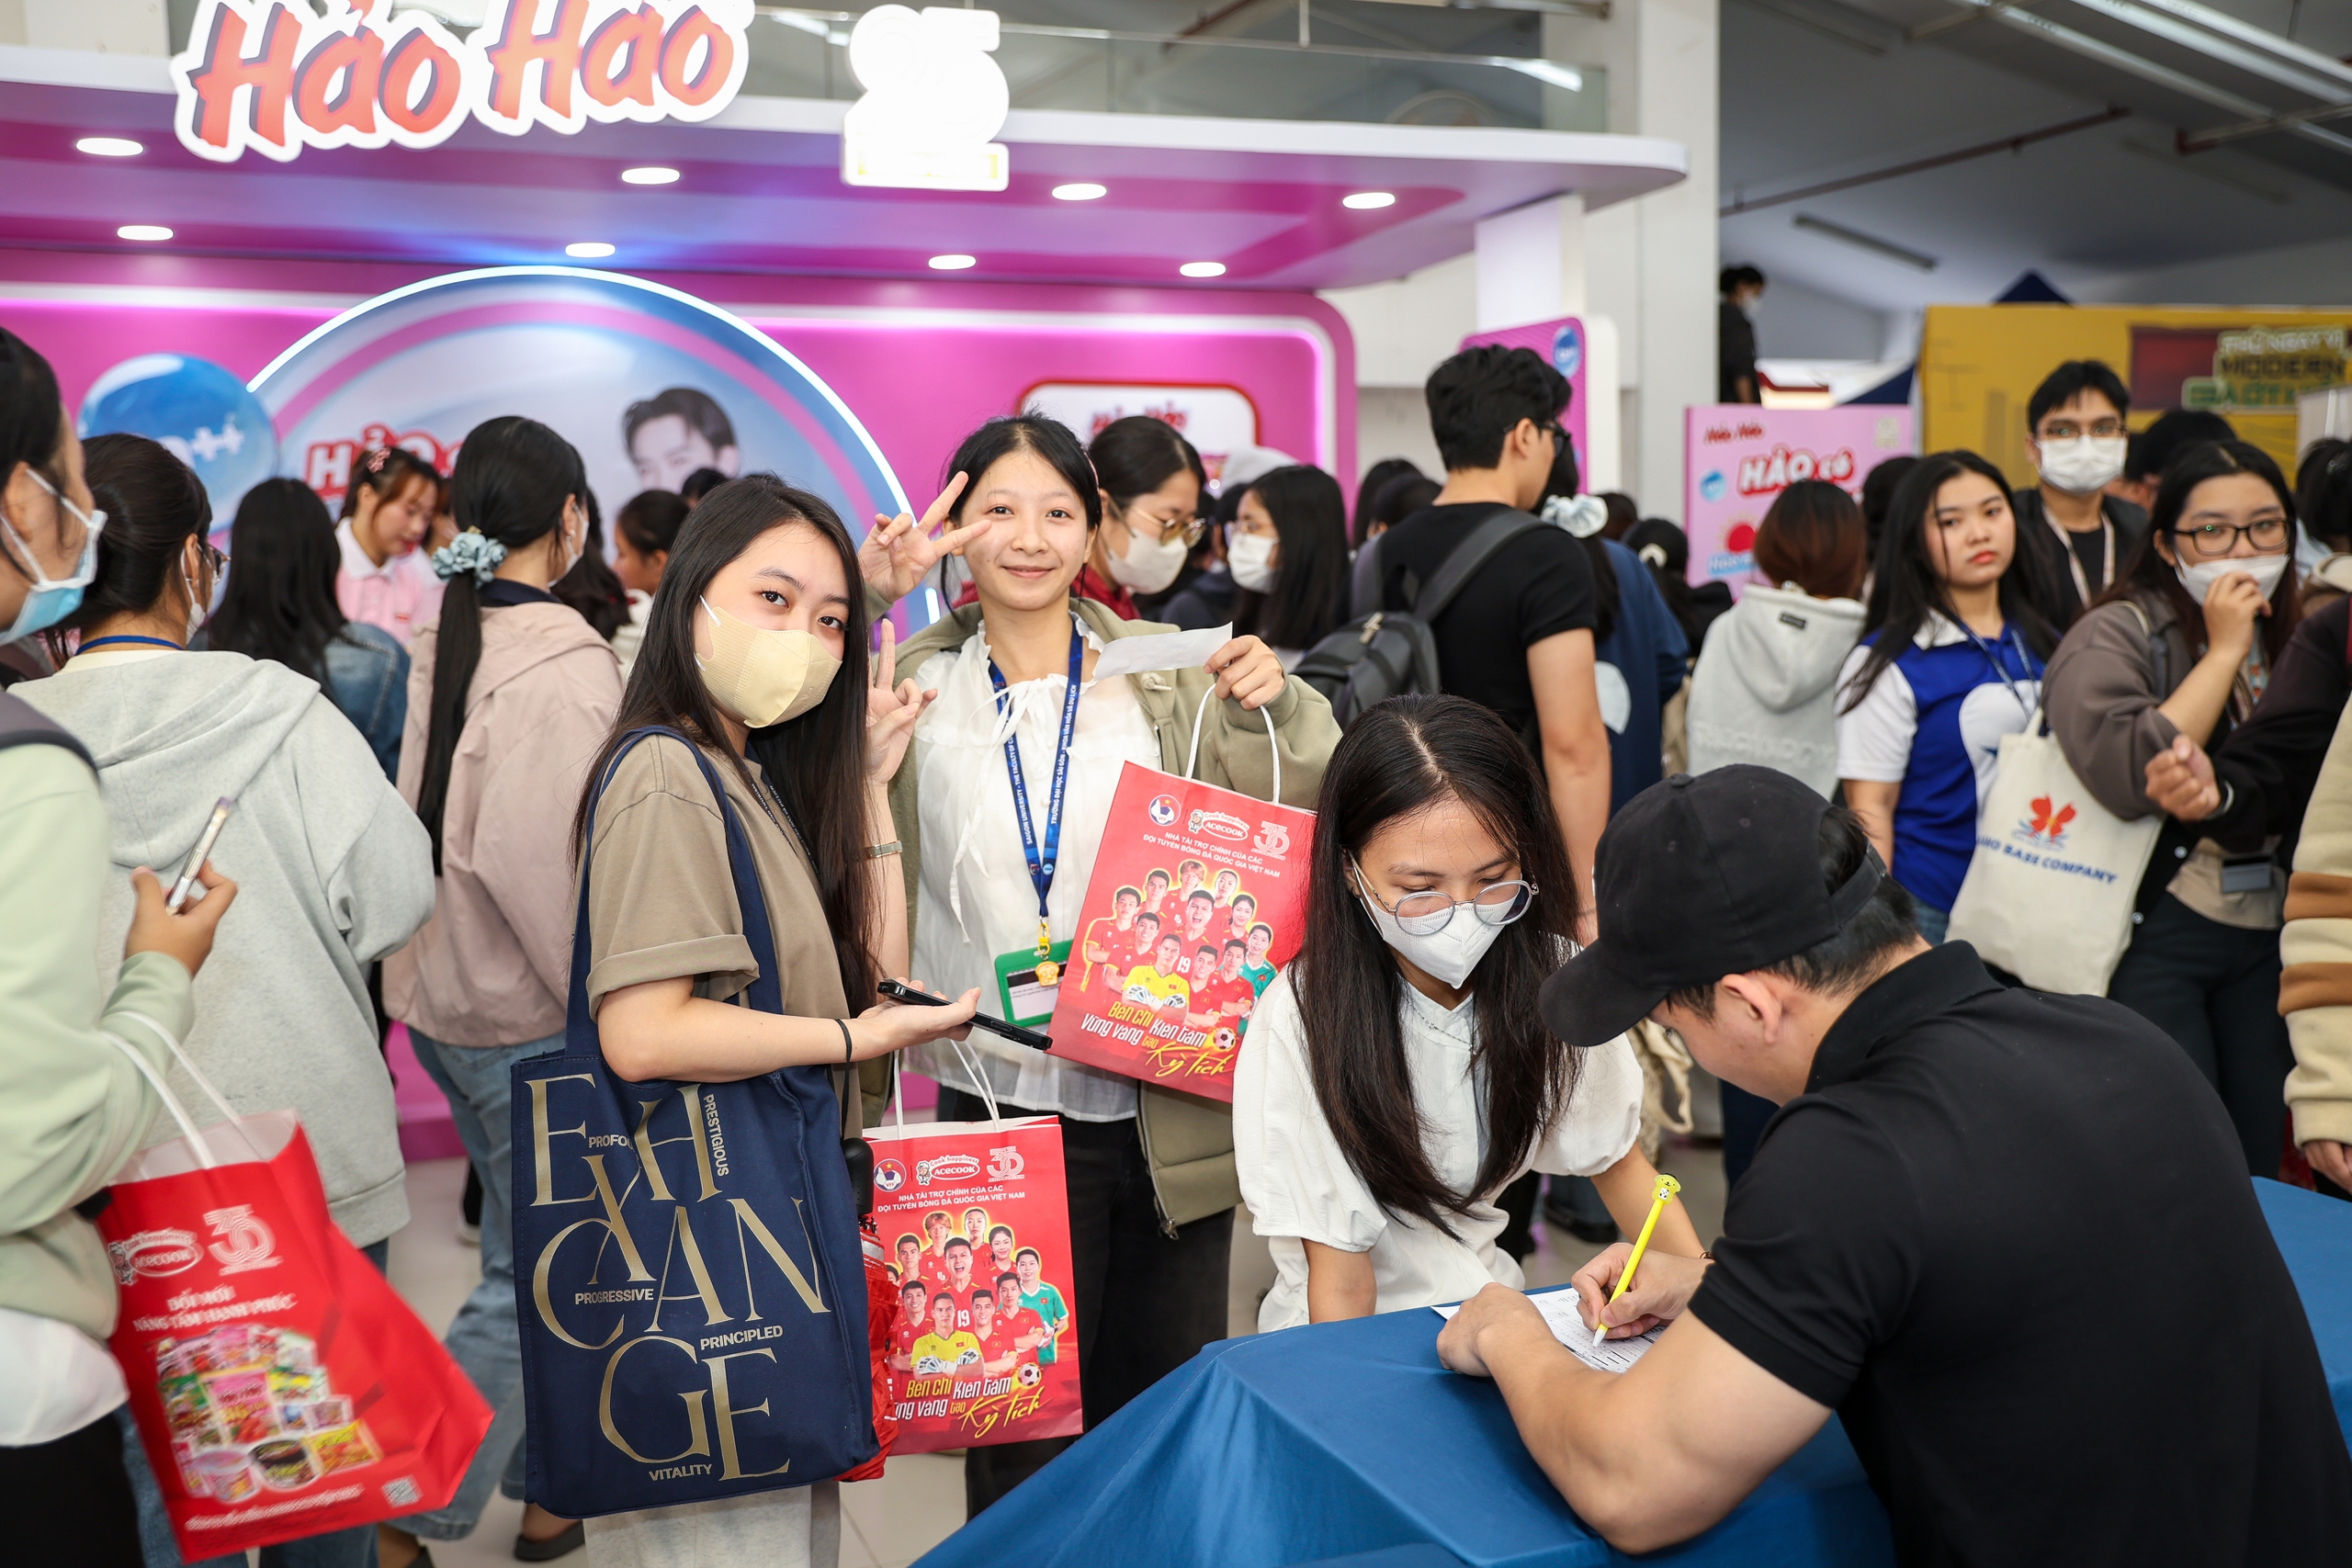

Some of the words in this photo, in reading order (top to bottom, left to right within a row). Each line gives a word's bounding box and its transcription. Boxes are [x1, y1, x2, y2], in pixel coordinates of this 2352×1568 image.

[1010, 753, 1020, 775] FACULTY
[1017, 789, 1028, 822] UNIVERSITY
[1023, 821, 1033, 845] SAIGON
[1165, 832, 1180, 841] NHÀ
[1182, 836, 1193, 845] TÀI
[1194, 840, 1209, 850] TRỢ
[1209, 845, 1231, 856] CHÍNH
[1232, 851, 1246, 860] CỦA
[1248, 855, 1262, 864] CÁC
[1181, 845, 1202, 856] BÓNG
[1202, 851, 1213, 859] ĐÁ
[1235, 860, 1247, 869] GIA
[1248, 863, 1263, 873] VIỆT
[1264, 868, 1281, 878] NAM
[2041, 857, 2118, 885] COMPANY
[1176, 955, 1191, 974] 19
[588, 1134, 634, 1150] PROFOU
[703, 1093, 729, 1178] PRESTIGIOUS
[930, 1156, 945, 1167] Cook
[946, 1154, 979, 1165] happiness
[899, 1192, 915, 1201] NHÀ
[915, 1191, 928, 1200] TÀI
[946, 1188, 968, 1196] CHÍNH
[970, 1186, 987, 1194] CỦA
[919, 1200, 940, 1208] BÓNG
[990, 1192, 1007, 1201] VIỆT
[1009, 1191, 1025, 1200] NAM
[574, 1288, 654, 1305] PROGRESSIVE
[957, 1309, 970, 1328] 19
[699, 1325, 785, 1350] PRINCIPLED
[649, 1463, 713, 1482] VITALITY
